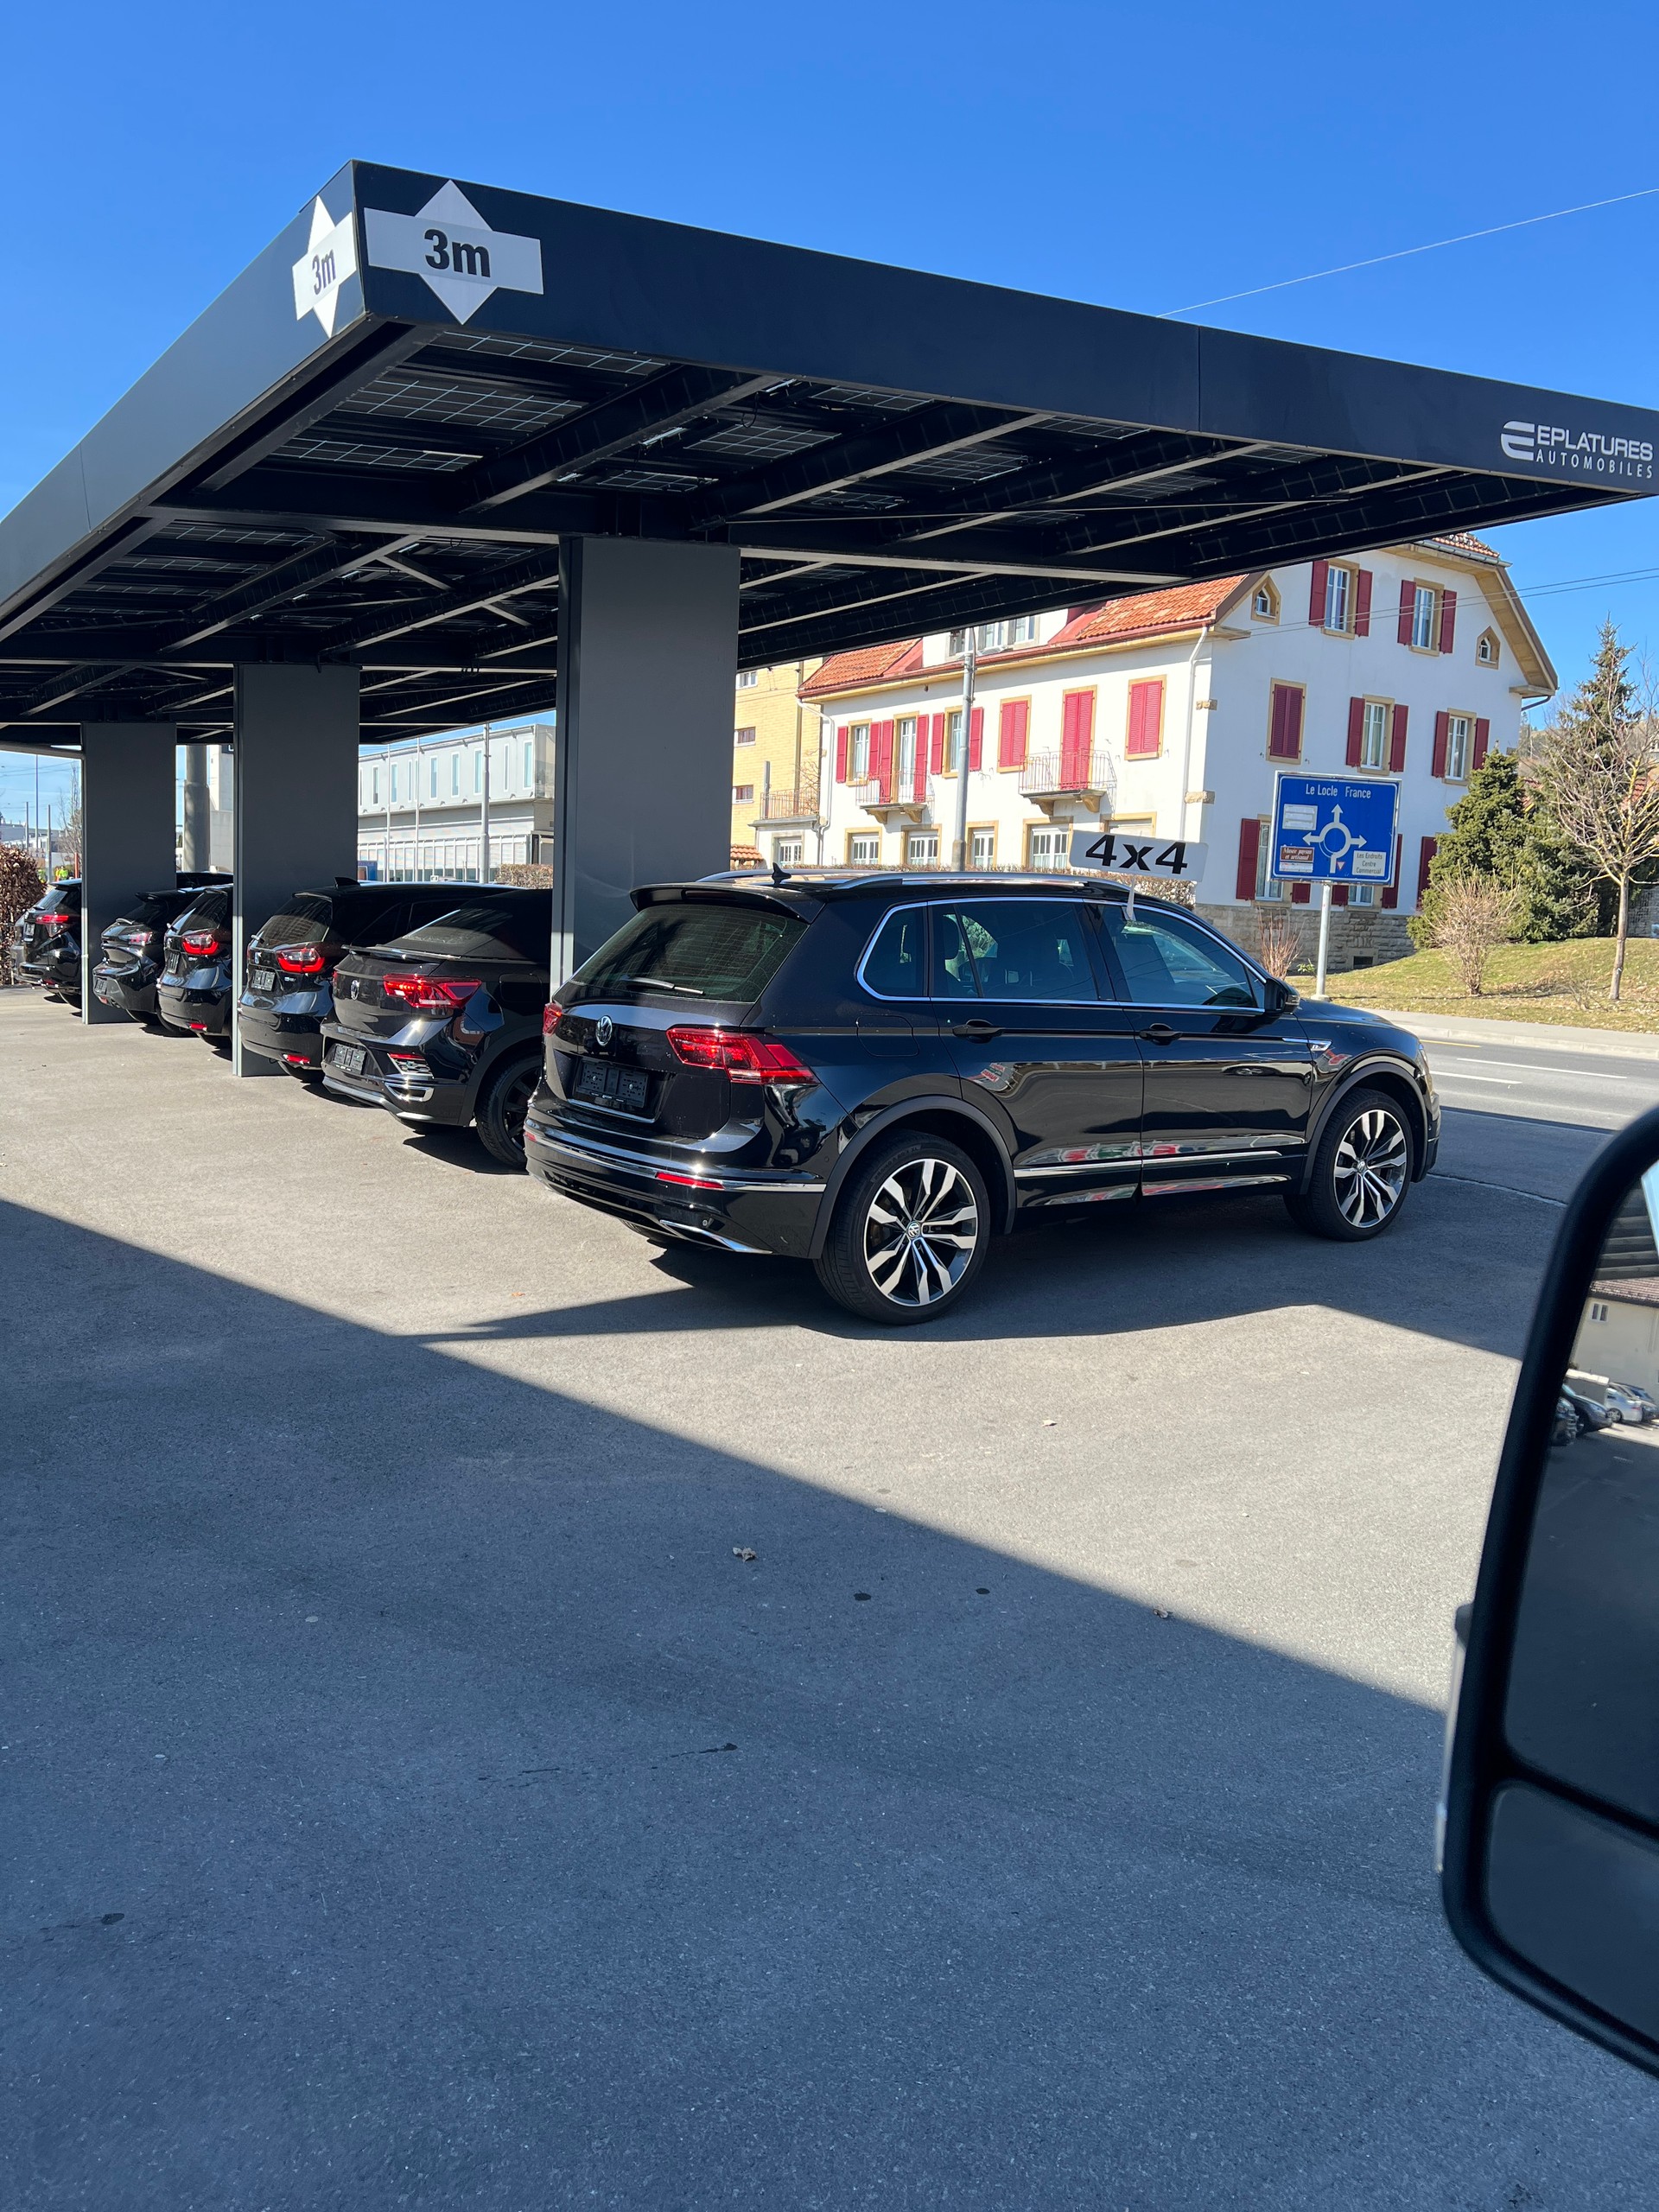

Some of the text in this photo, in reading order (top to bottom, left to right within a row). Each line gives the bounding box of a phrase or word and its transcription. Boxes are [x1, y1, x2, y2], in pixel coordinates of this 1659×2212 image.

[423, 228, 491, 278] 3m
[311, 249, 337, 296] 3m
[1536, 424, 1654, 461] EPLATURES
[1535, 448, 1653, 479] AUTOMOBILES
[1306, 784, 1338, 797] Le Locle
[1345, 786, 1371, 798] France
[1085, 834, 1188, 874] 4x4
